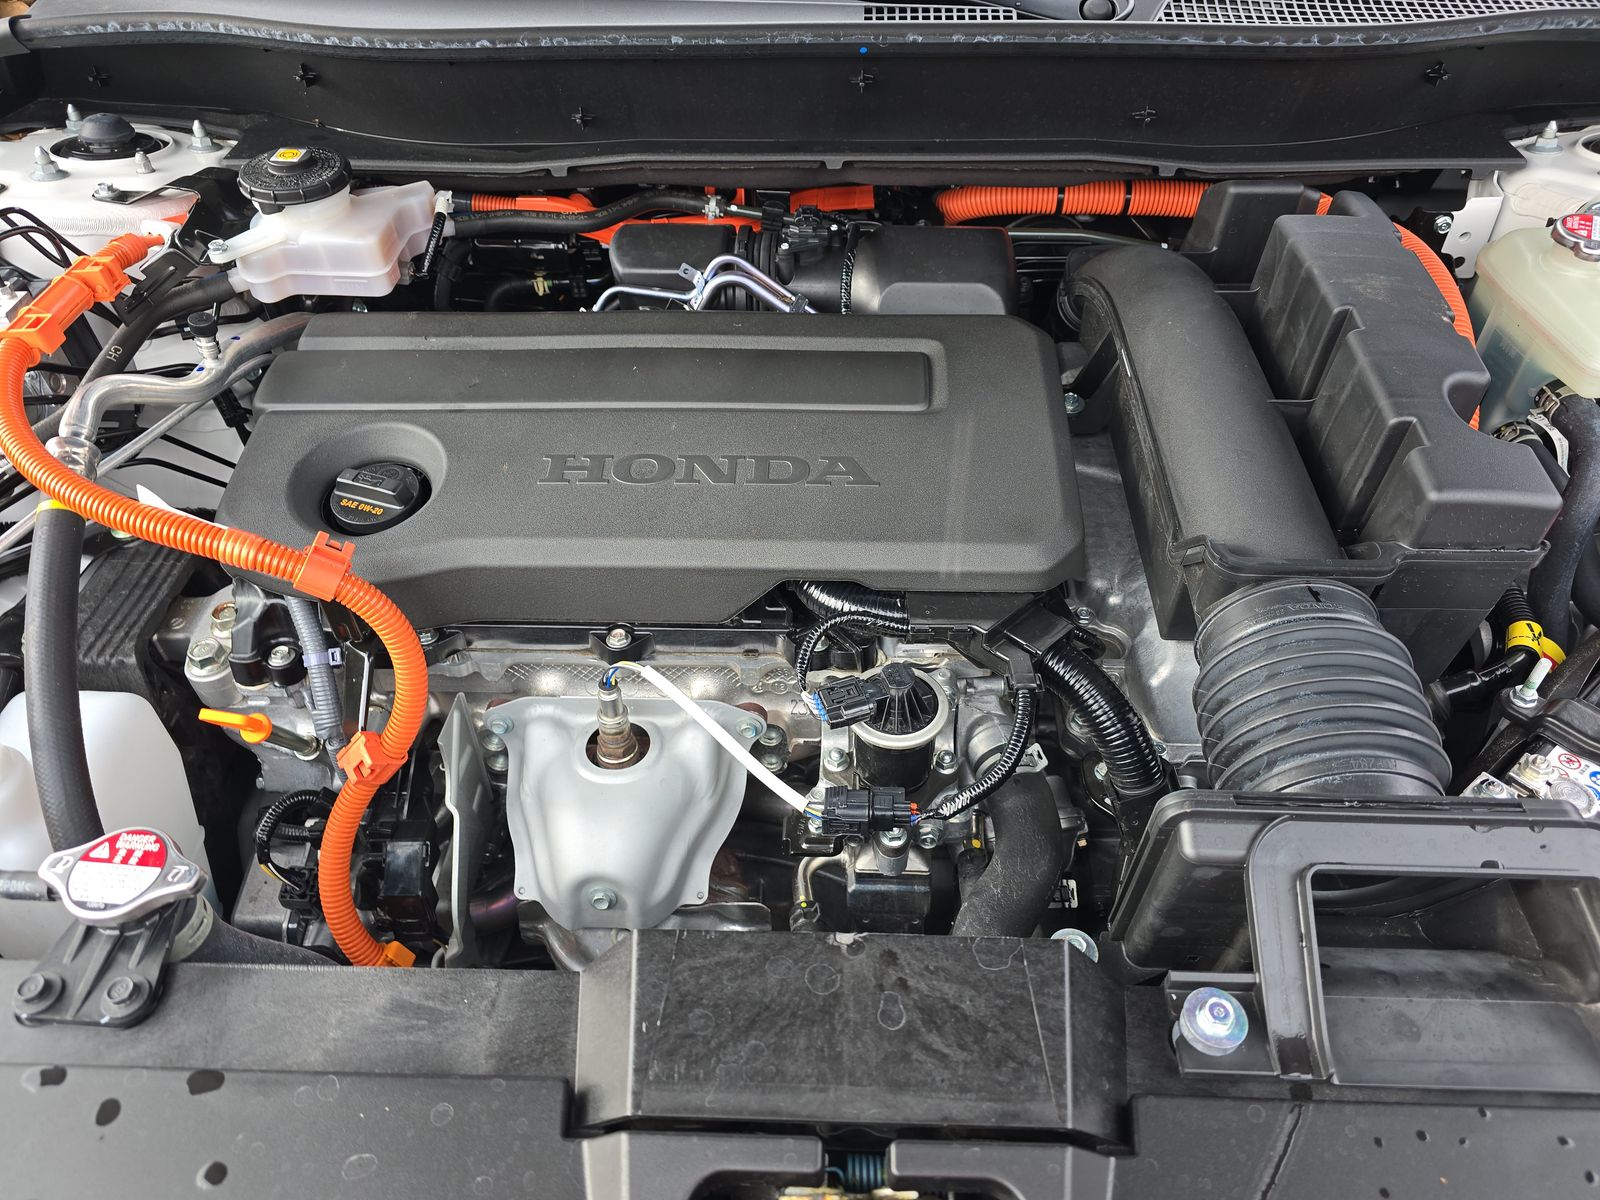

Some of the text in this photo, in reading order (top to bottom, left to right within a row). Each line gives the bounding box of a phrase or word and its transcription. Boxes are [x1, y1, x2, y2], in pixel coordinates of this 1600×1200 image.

[537, 453, 881, 487] HONDA
[340, 498, 384, 515] SAE 0W-20
